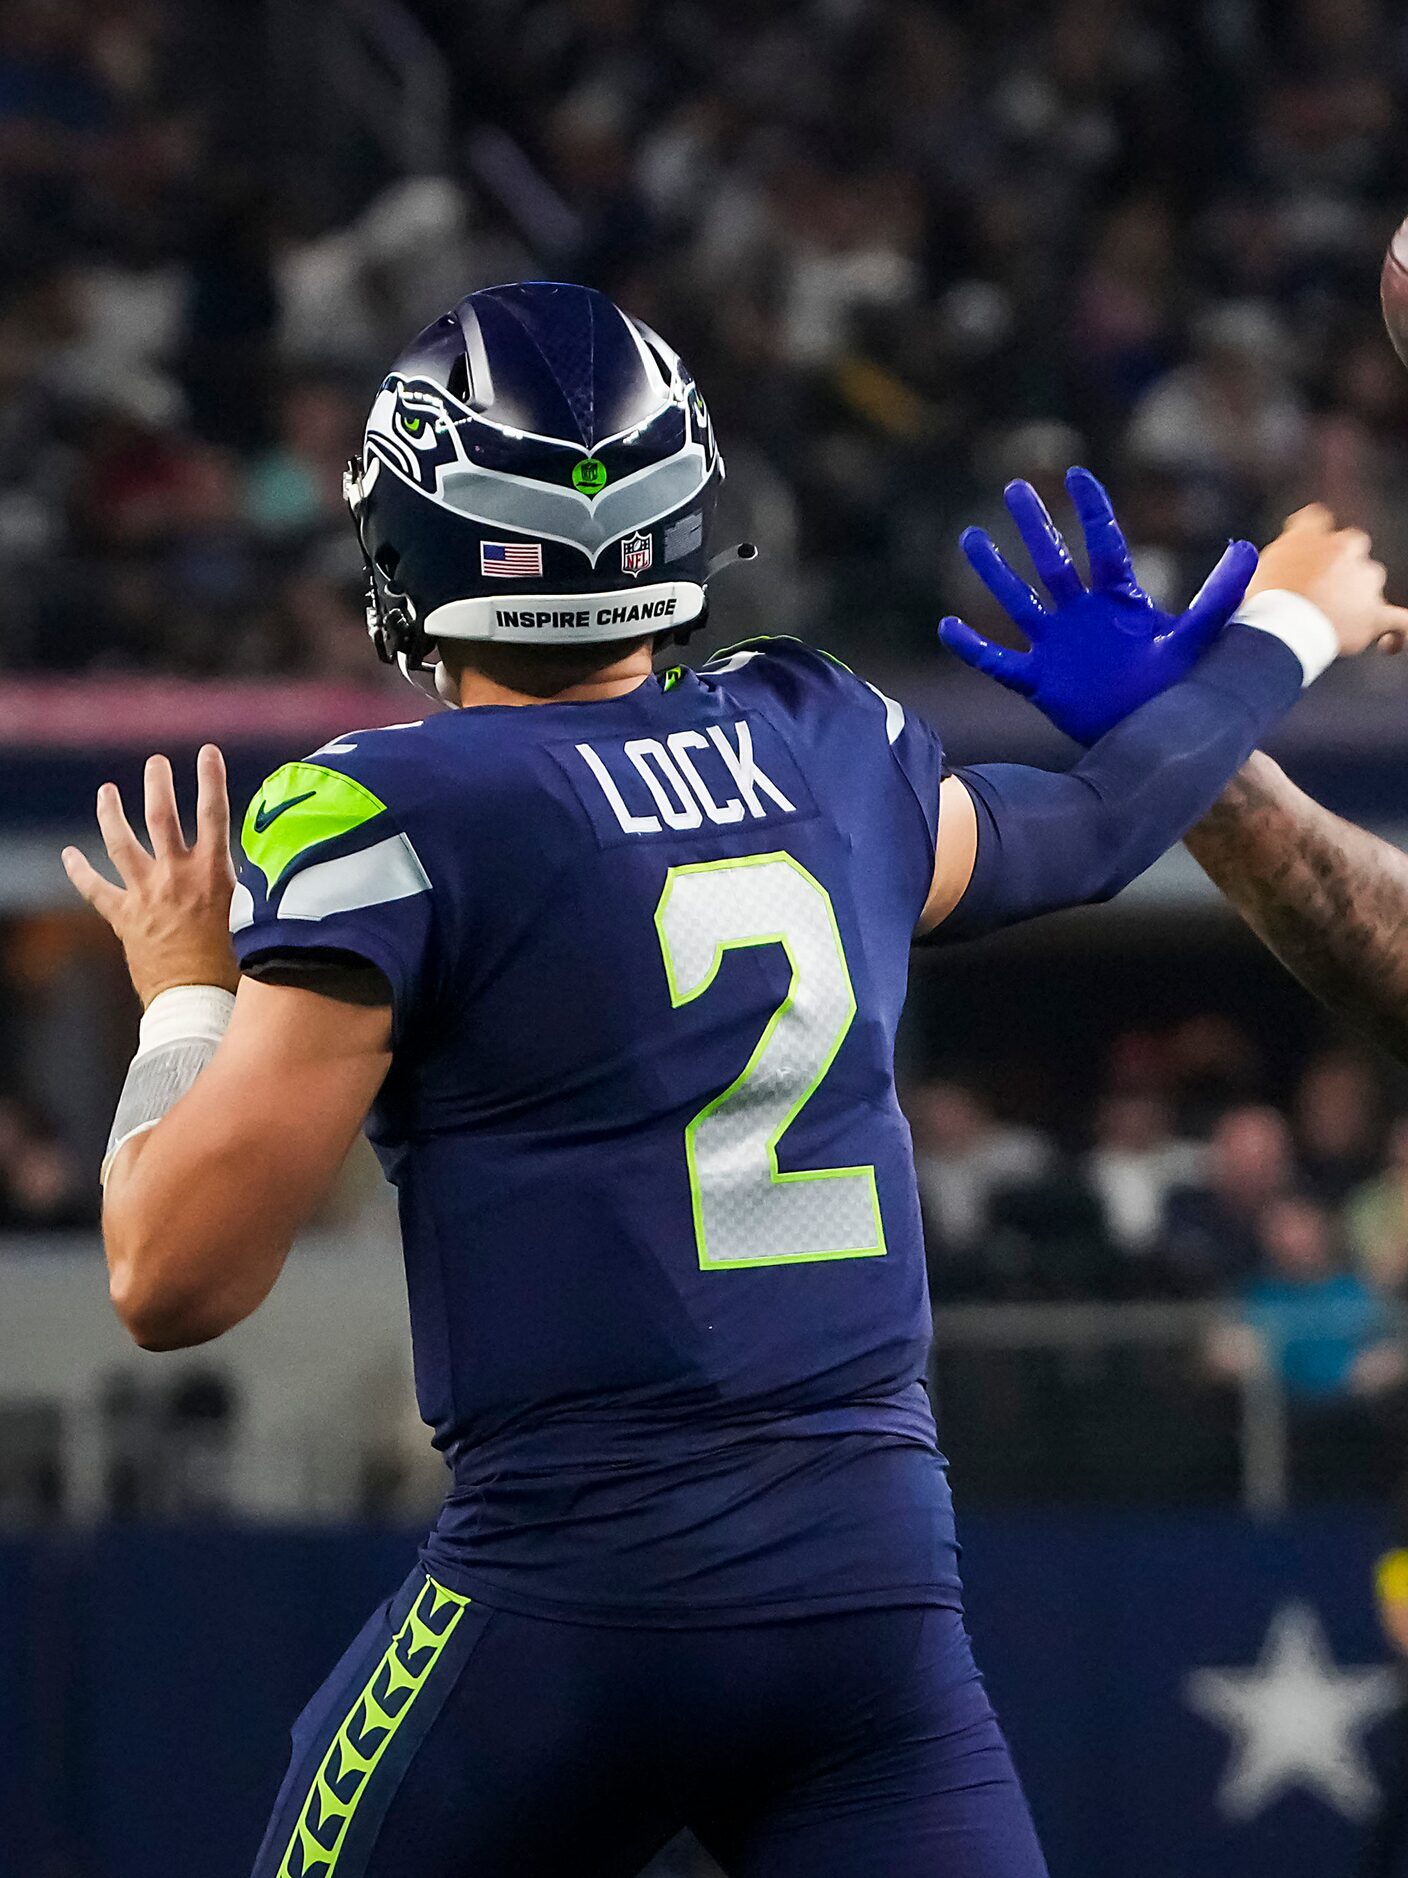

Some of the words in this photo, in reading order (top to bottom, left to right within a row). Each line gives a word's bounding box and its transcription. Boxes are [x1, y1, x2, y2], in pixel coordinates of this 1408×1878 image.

[626, 551, 648, 569] NFL
[496, 611, 590, 628] INSPIRE
[597, 599, 677, 625] CHANGE
[575, 720, 797, 834] LOCK
[654, 850, 887, 1271] 2
